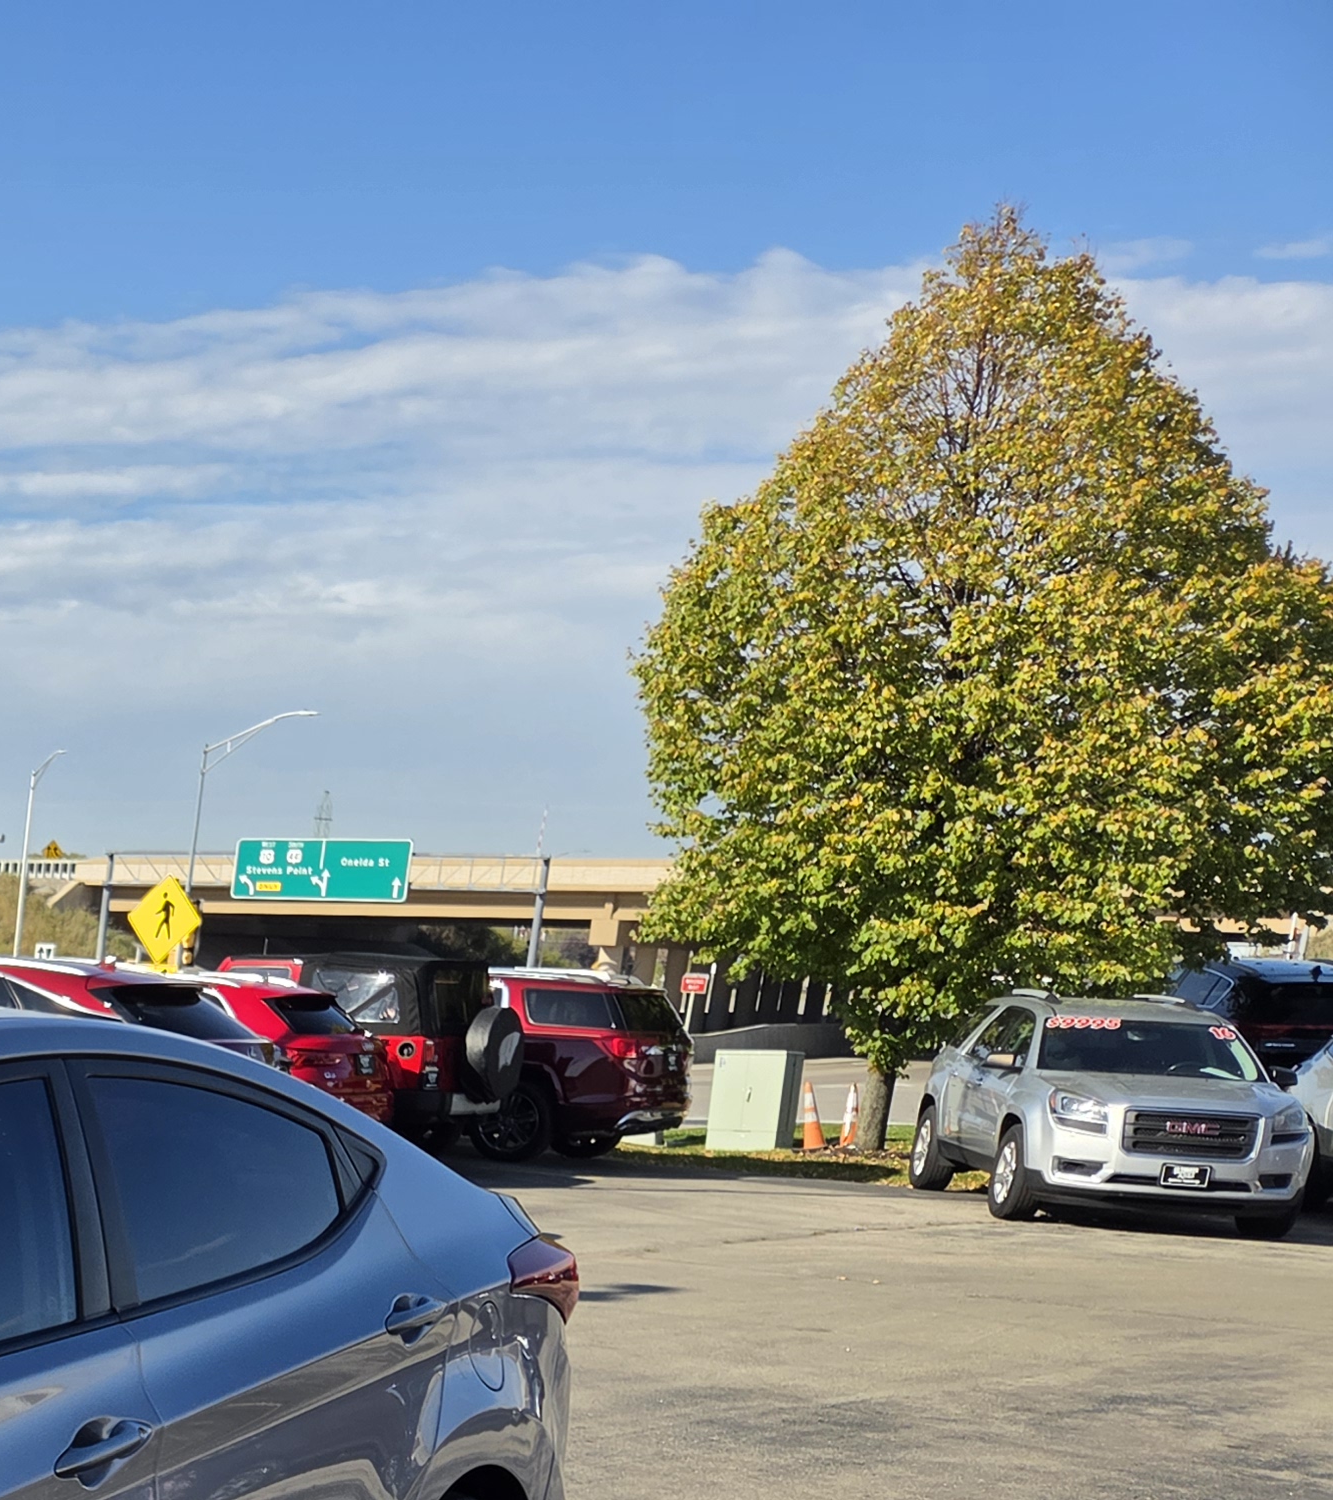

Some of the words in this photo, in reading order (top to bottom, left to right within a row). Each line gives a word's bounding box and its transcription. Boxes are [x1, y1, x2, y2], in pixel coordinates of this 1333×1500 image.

[340, 856, 375, 867] Oneida
[378, 857, 391, 867] St
[246, 865, 283, 875] Stevens
[286, 865, 314, 875] Point
[1046, 1015, 1123, 1031] $9995
[1166, 1121, 1221, 1136] GMC
